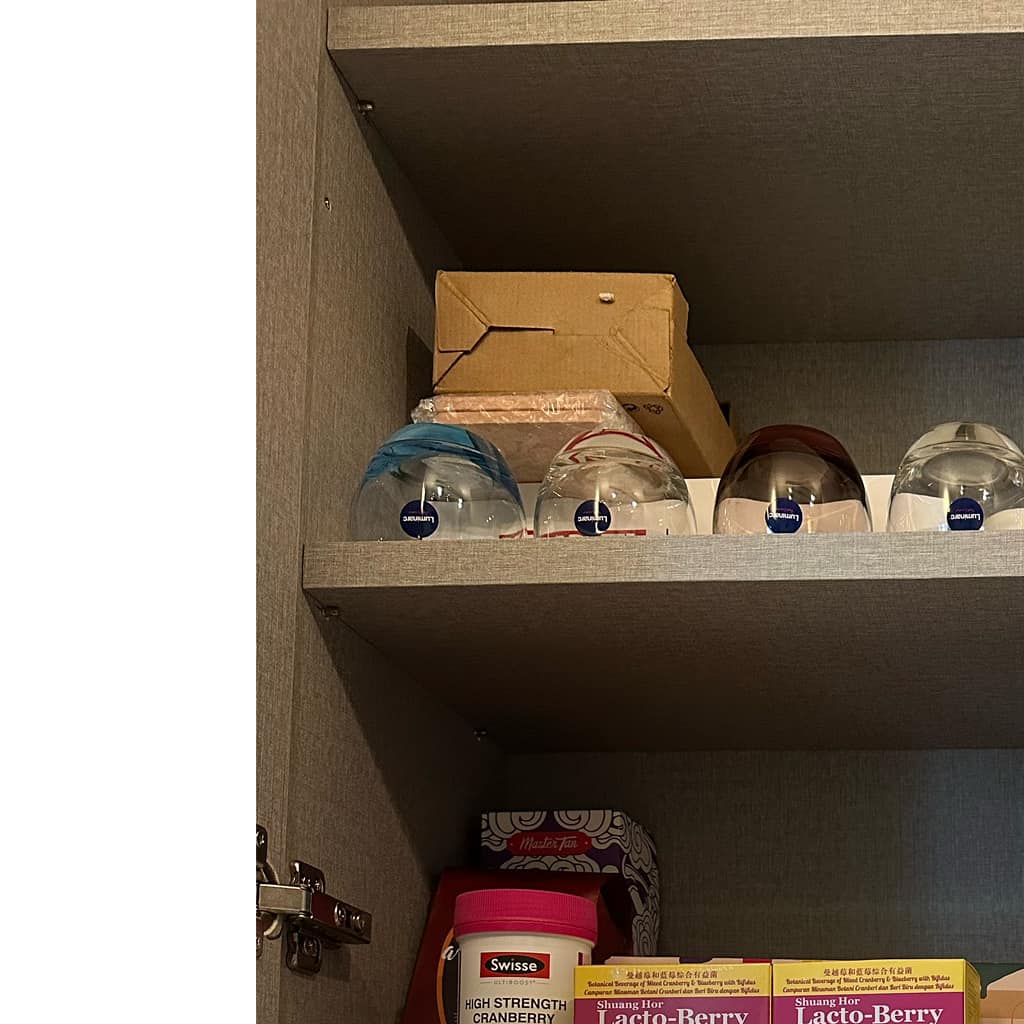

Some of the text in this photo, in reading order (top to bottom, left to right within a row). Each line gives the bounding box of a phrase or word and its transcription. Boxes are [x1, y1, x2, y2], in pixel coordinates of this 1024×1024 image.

[402, 515, 434, 524] Luminarc
[951, 512, 981, 521] Luminarc
[490, 958, 538, 972] Swisse
[465, 998, 567, 1011] HIGH STRENGTH
[597, 1000, 664, 1010] Shuang Hor
[795, 996, 861, 1008] Shuang Hor
[473, 1012, 555, 1024] CRANBERRY
